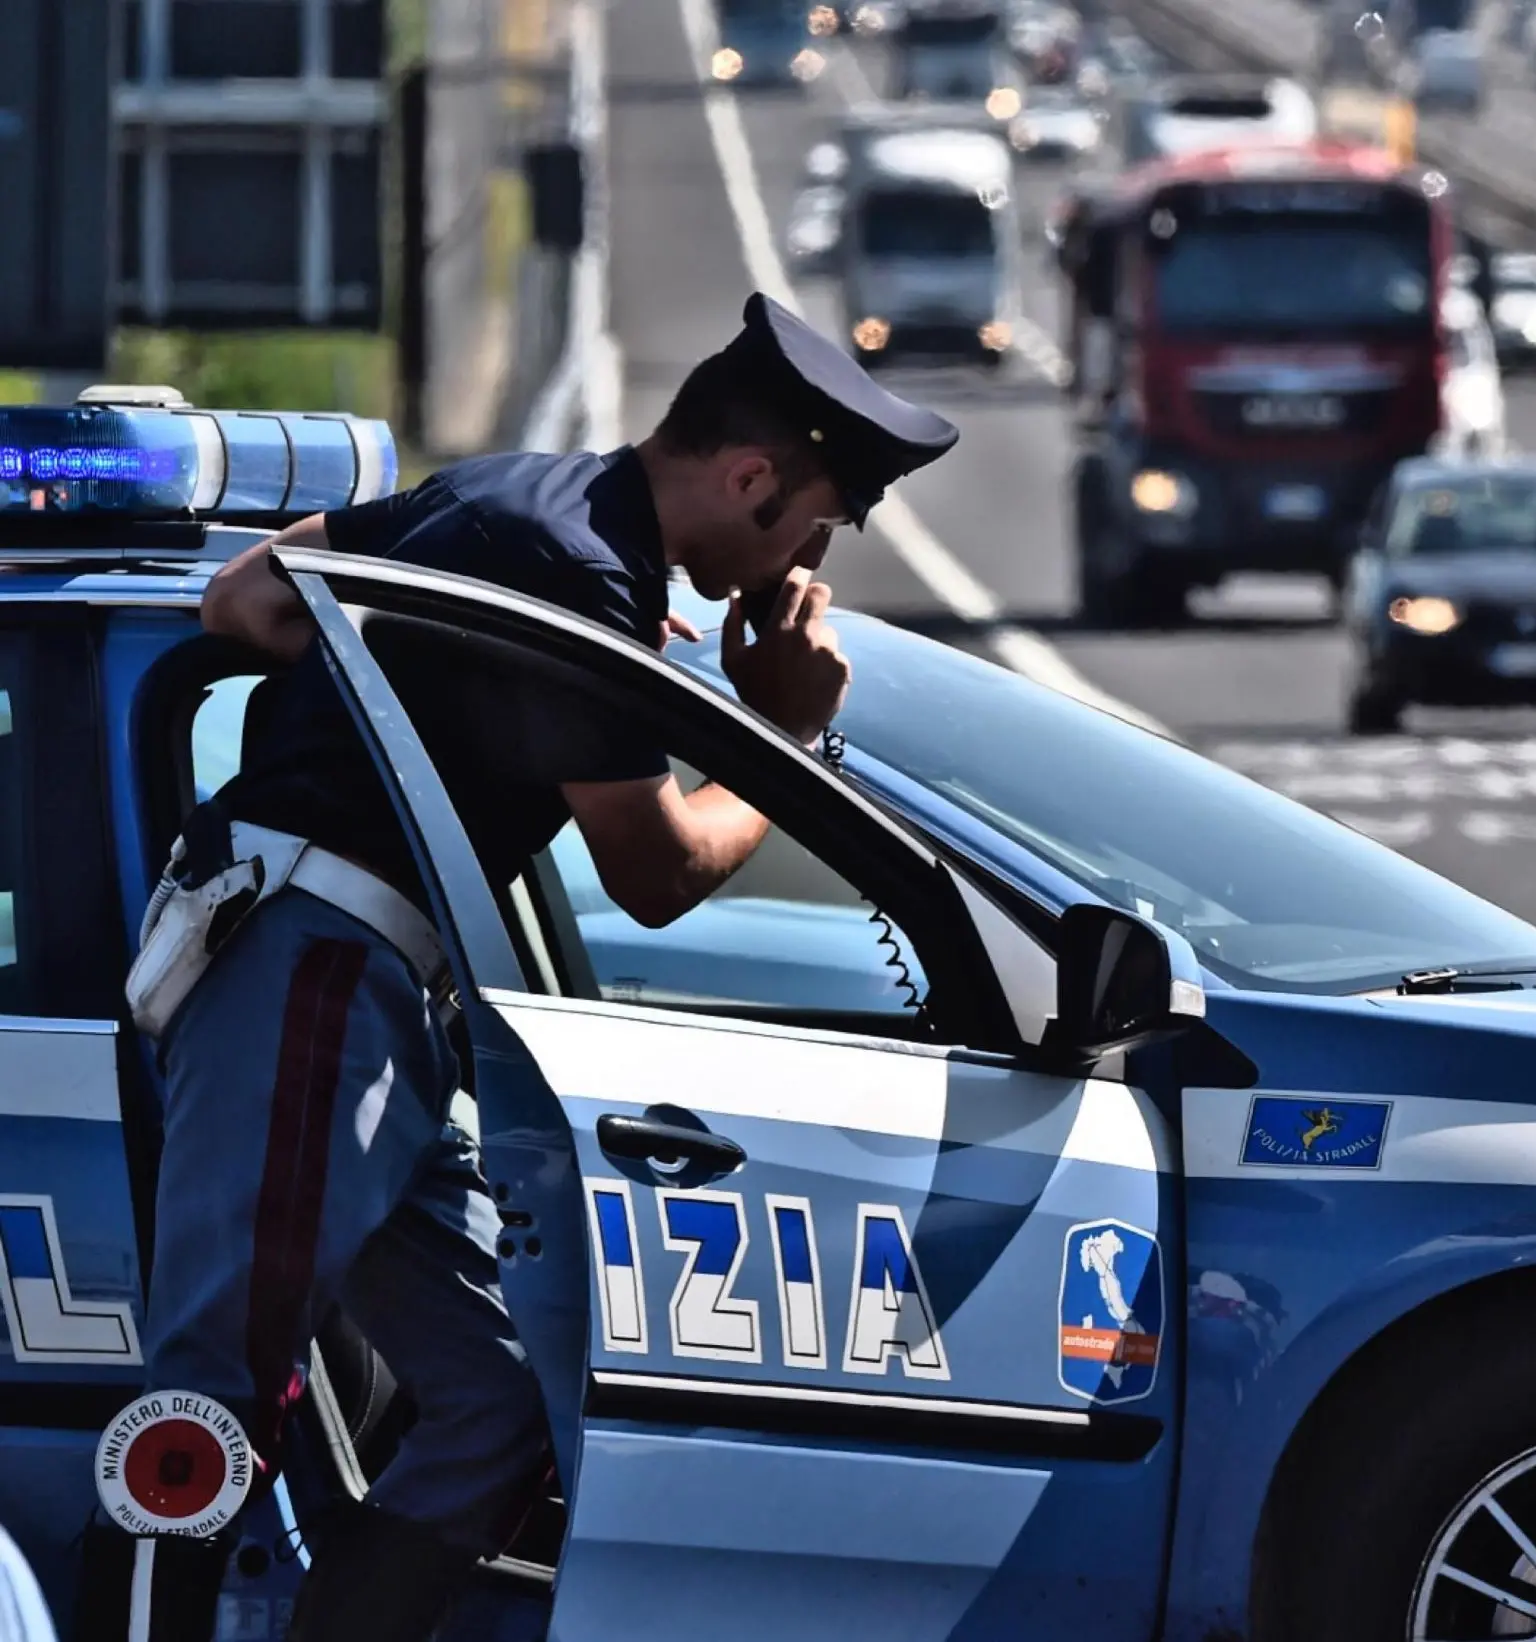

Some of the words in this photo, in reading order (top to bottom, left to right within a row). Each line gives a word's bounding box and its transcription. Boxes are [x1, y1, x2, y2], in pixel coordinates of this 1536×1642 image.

[1315, 1134, 1377, 1163] STRADALE
[103, 1399, 164, 1480] MINISTERO
[172, 1396, 247, 1487] DELL'INTERNO
